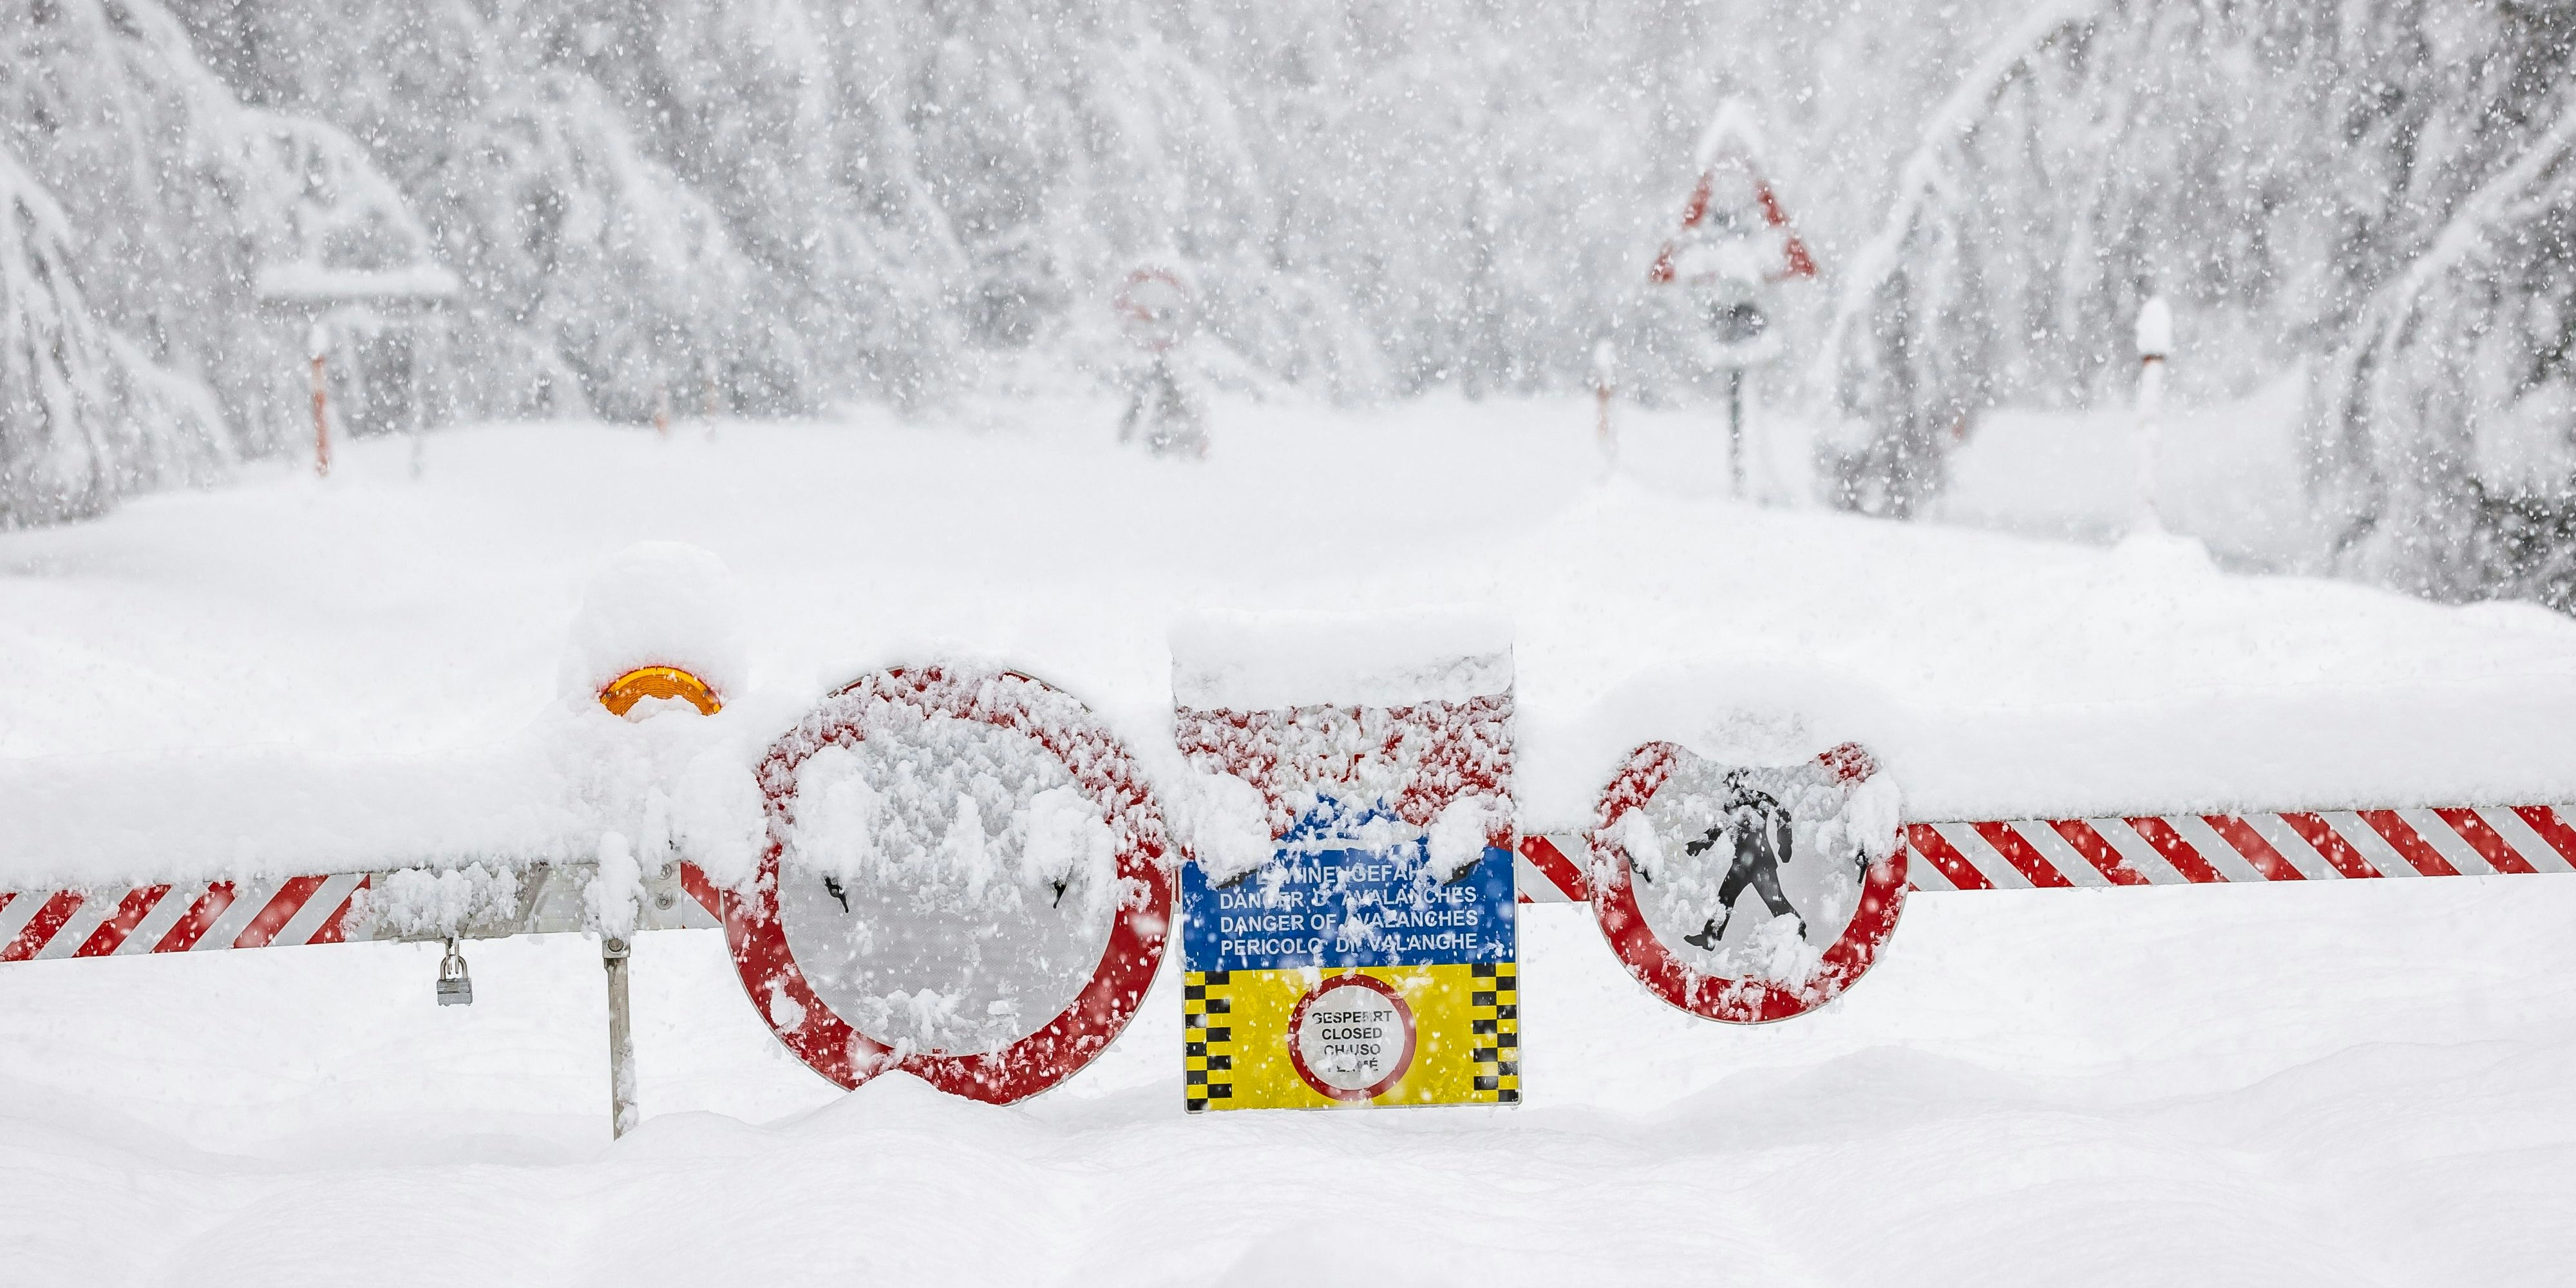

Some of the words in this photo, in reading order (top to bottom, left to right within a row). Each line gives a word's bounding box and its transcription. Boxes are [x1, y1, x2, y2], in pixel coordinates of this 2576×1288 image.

[1220, 914, 1305, 933] DANGER
[1311, 914, 1337, 931] OF
[1221, 937, 1322, 956] PERICOLO
[1368, 933, 1477, 952] VALANGHE
[1321, 1027, 1383, 1040] CLOSED
[1324, 1043, 1381, 1056] CHUSO
